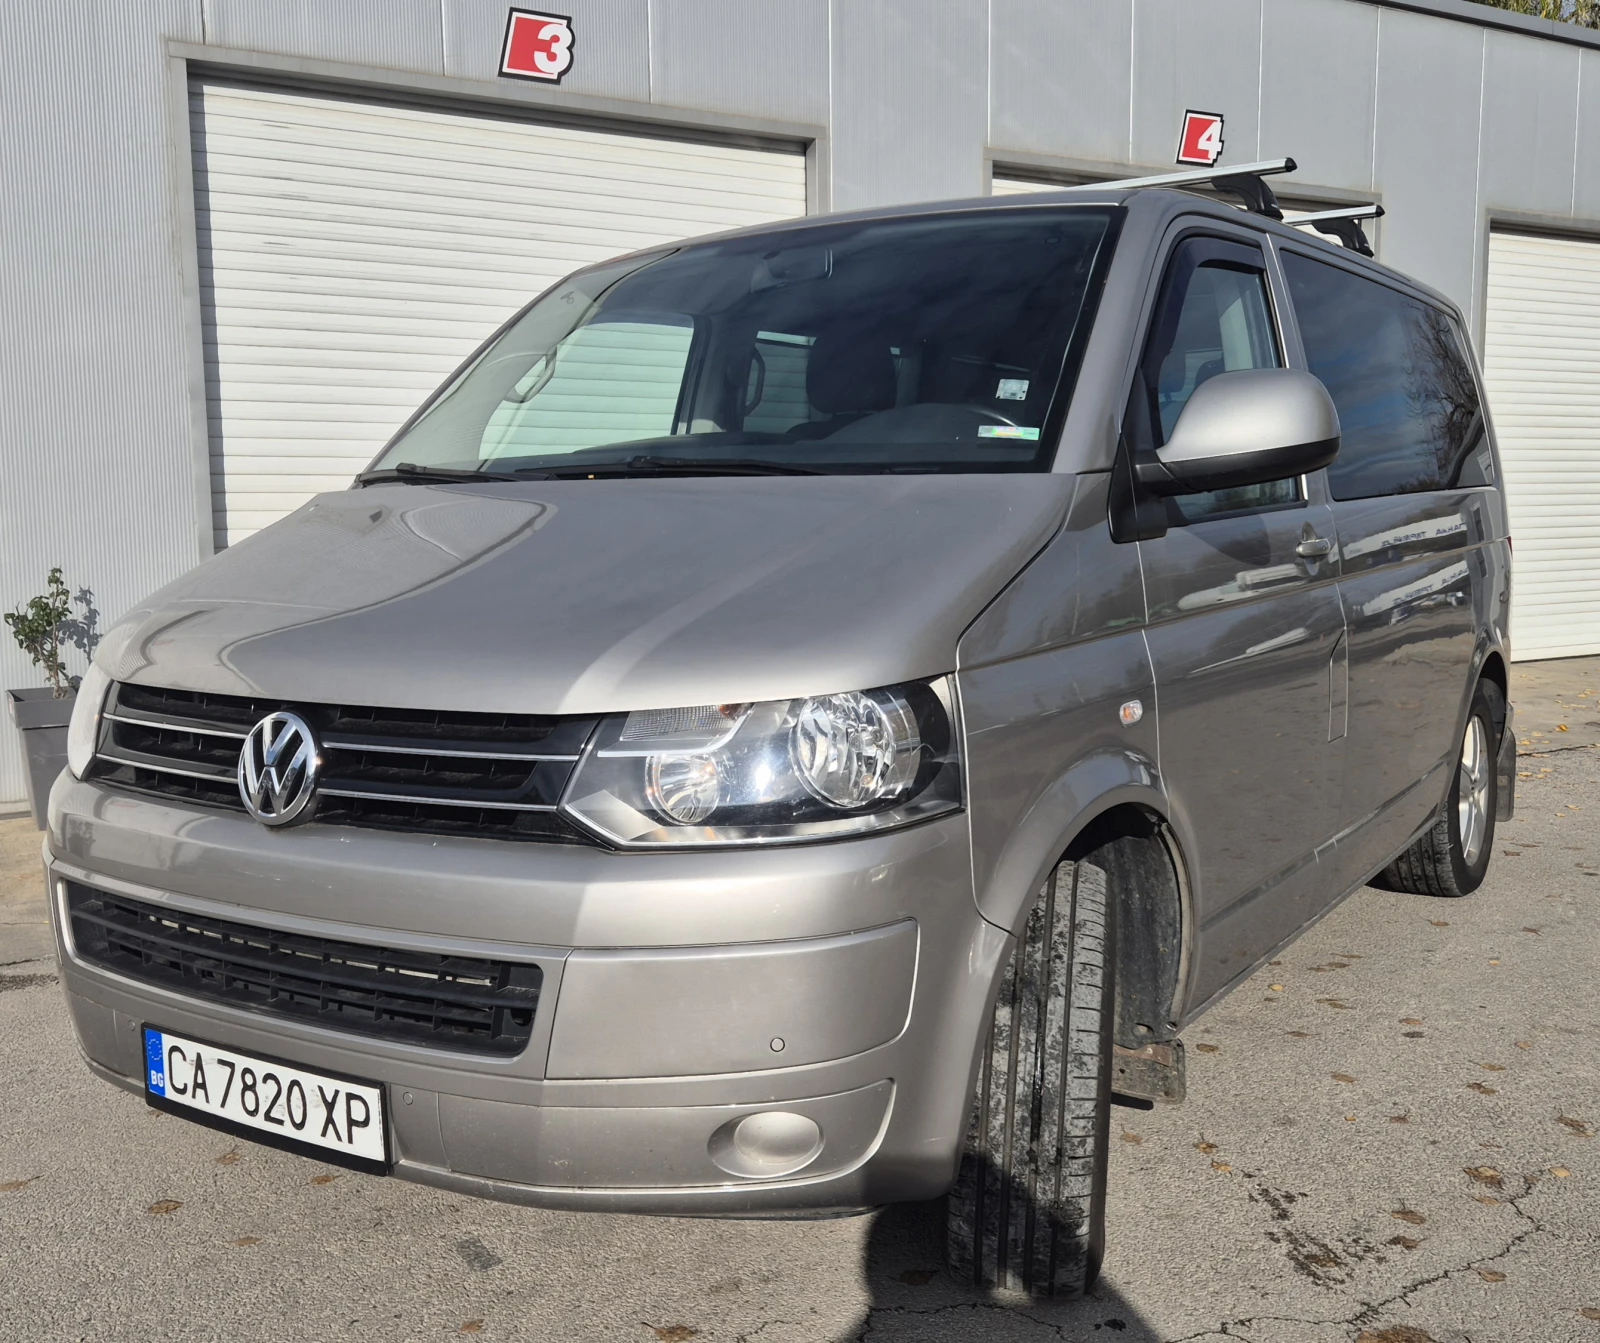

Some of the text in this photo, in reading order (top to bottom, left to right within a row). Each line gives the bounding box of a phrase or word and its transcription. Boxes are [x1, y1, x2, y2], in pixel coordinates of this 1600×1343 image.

[533, 23, 573, 74] 3
[1197, 120, 1223, 160] 4
[238, 711, 316, 825] VW
[151, 1070, 164, 1088] BG
